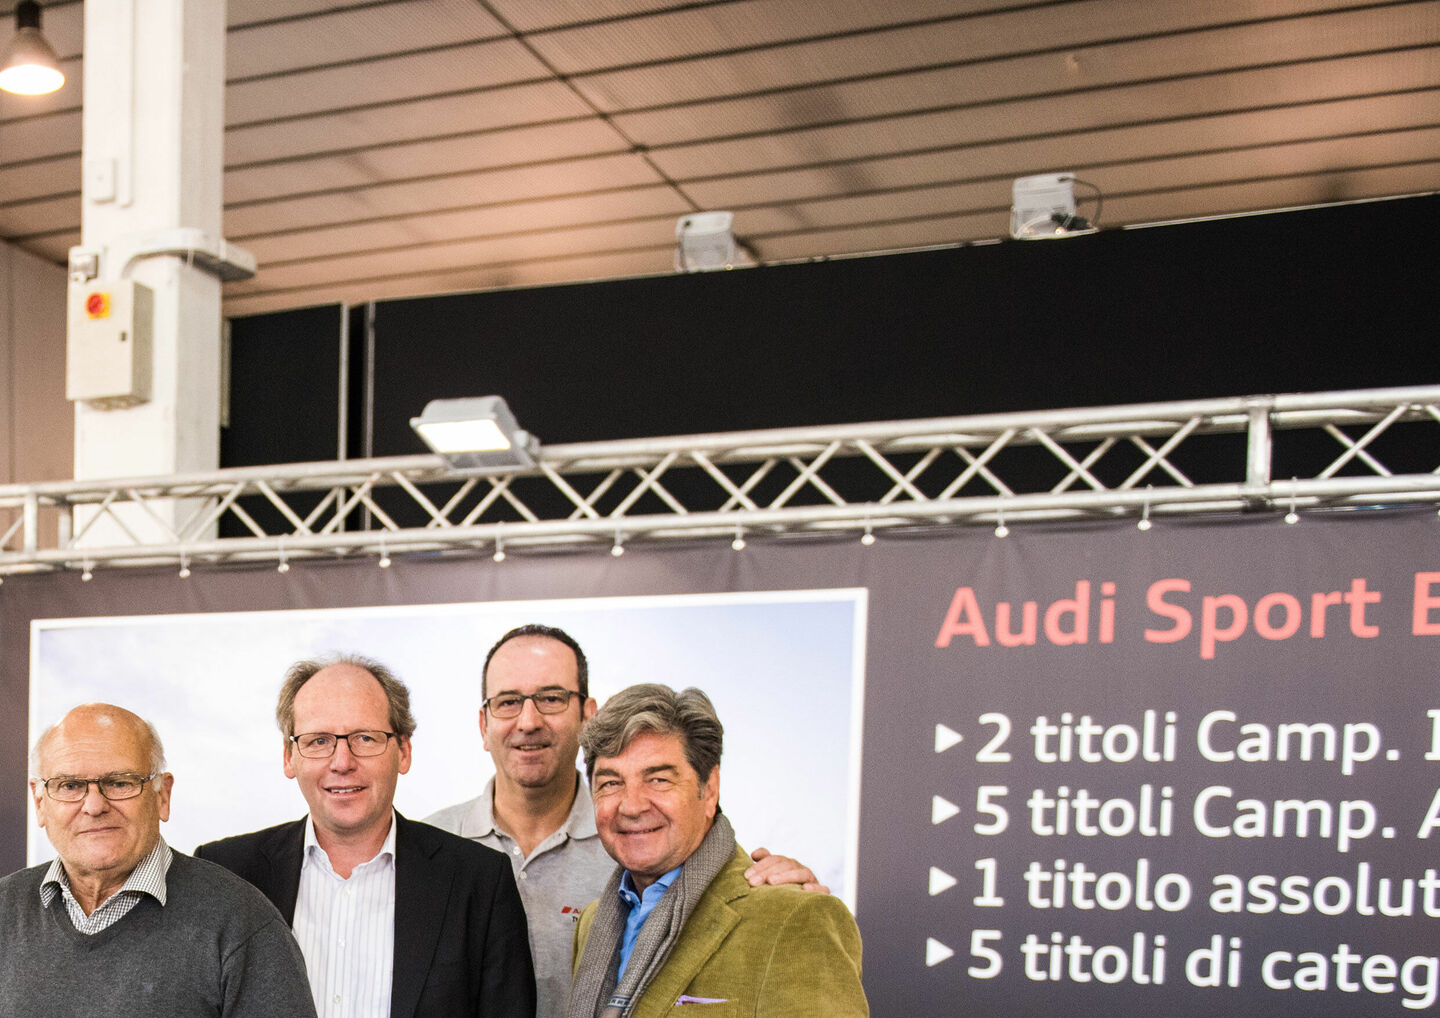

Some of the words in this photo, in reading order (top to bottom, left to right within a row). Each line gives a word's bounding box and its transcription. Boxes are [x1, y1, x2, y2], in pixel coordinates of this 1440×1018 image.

[934, 580, 1116, 648] Audi
[1144, 578, 1382, 660] Sport
[975, 712, 1013, 763] 2
[1030, 709, 1178, 764] titoli
[1196, 710, 1400, 776] Camp.
[973, 785, 1010, 836] 5
[1027, 784, 1174, 837] titoli
[1193, 785, 1397, 853] Camp.
[973, 857, 1005, 907] 1
[1024, 857, 1192, 912] titolo
[1209, 861, 1440, 919] assolut
[968, 929, 1003, 979] 5
[1020, 931, 1166, 985] titoli
[1185, 934, 1242, 988] di
[1261, 943, 1440, 1010] categ
